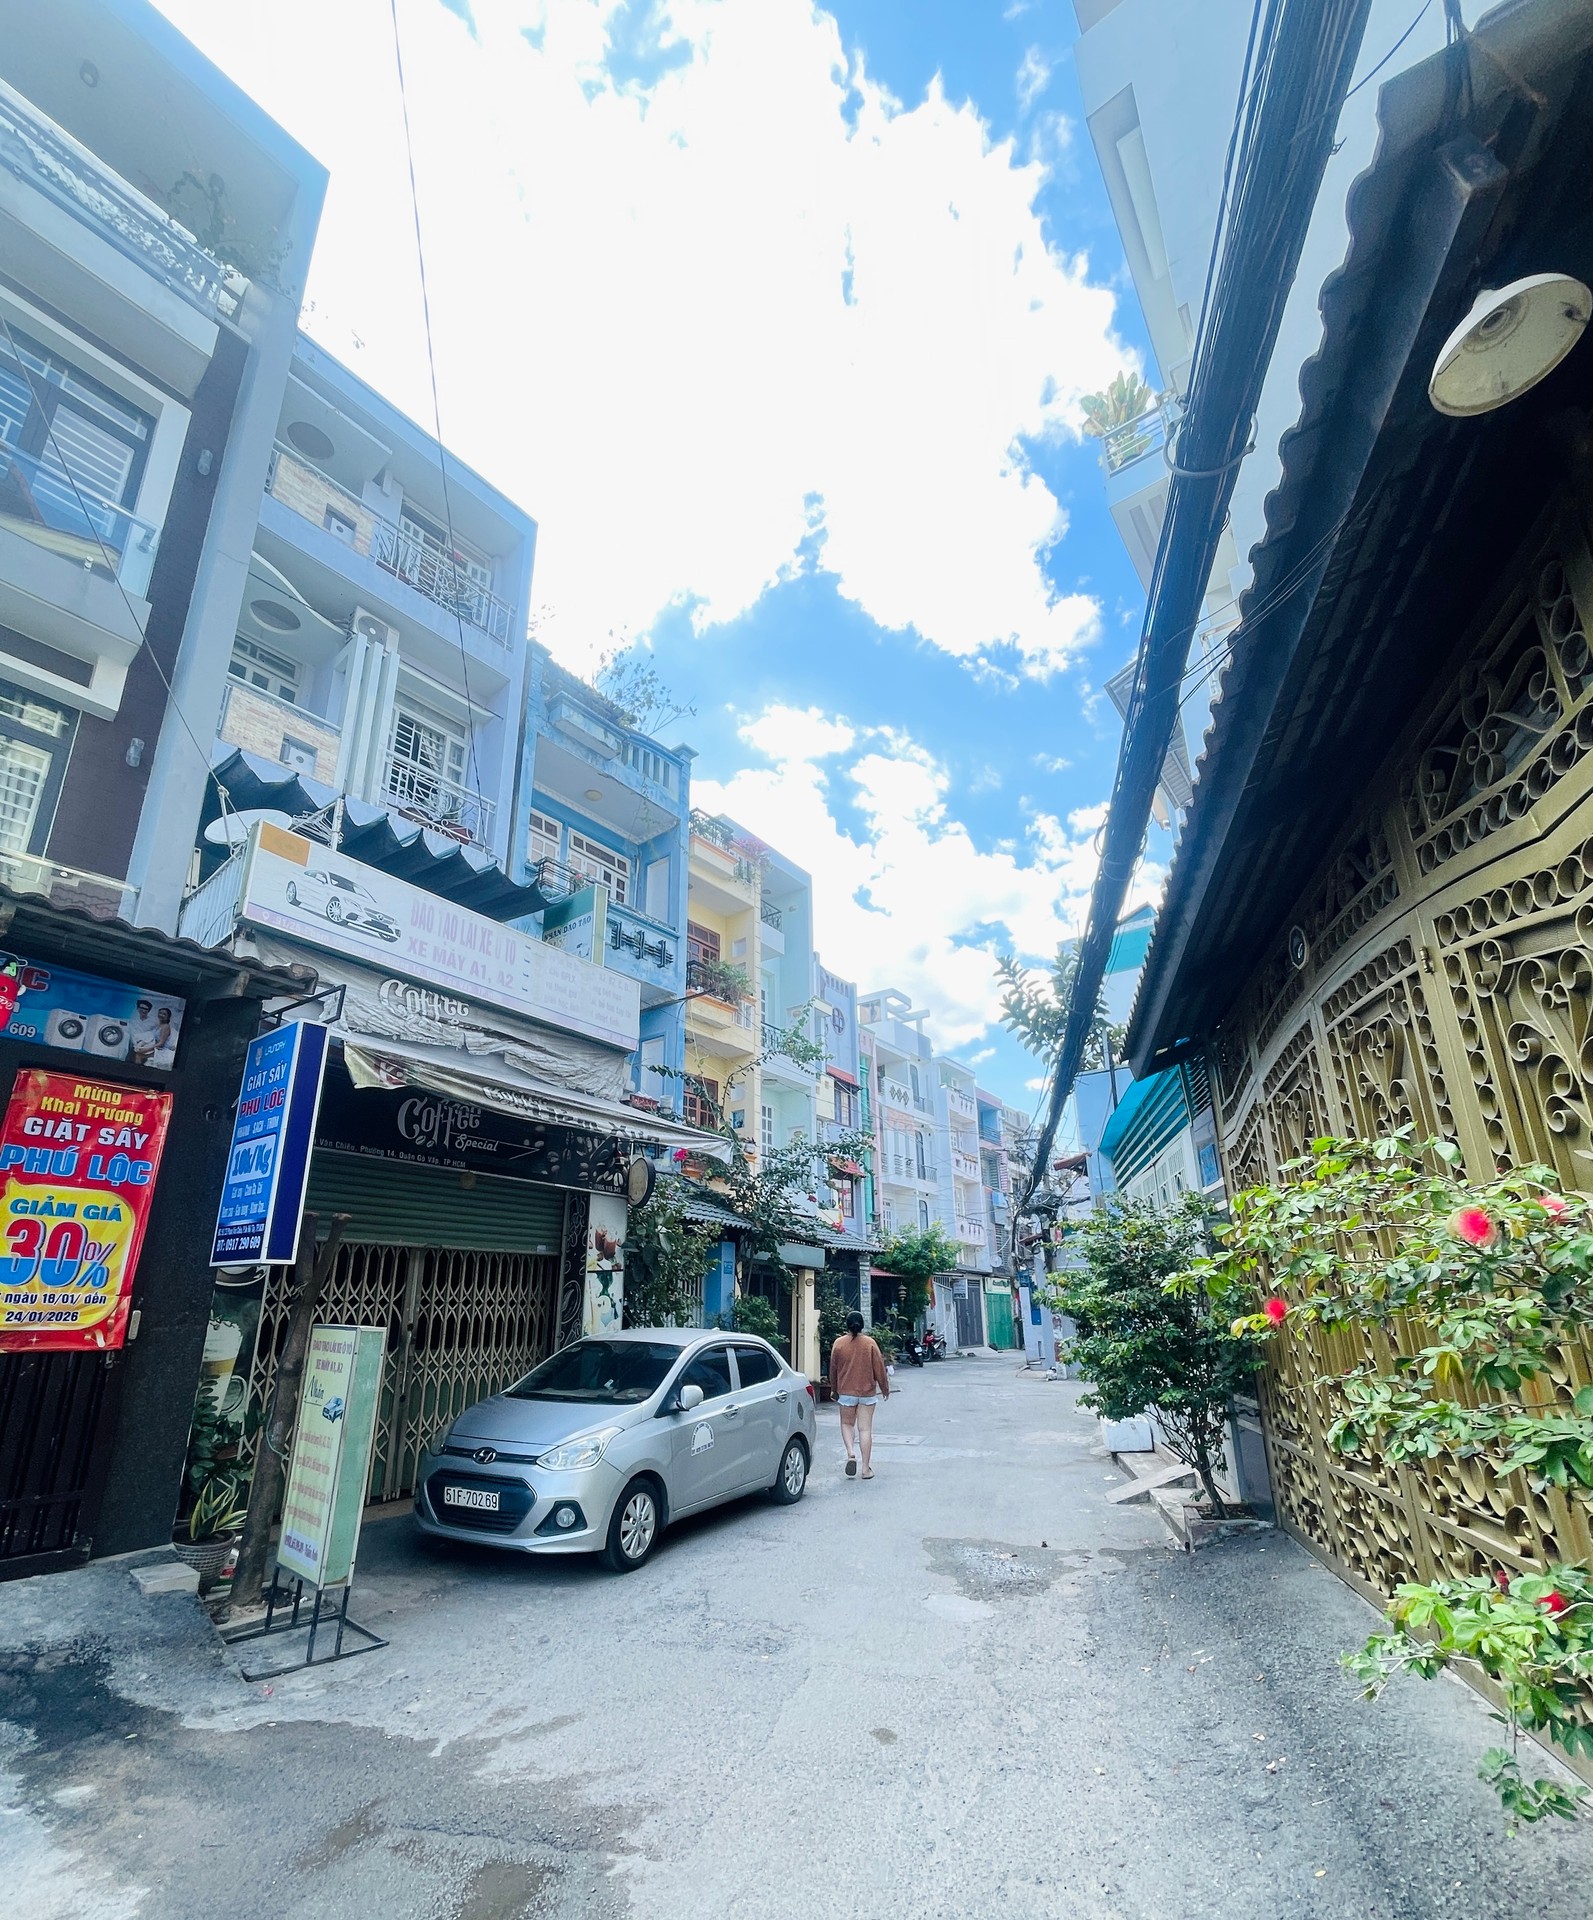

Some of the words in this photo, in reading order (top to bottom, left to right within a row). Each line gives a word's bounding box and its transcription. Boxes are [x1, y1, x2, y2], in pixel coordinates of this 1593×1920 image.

[407, 936, 428, 957] XE
[73, 1084, 122, 1105] Mừng
[40, 1096, 81, 1115] Khai
[86, 1103, 144, 1126] Trương
[23, 1117, 91, 1142] GIẶT
[97, 1126, 149, 1150] SẤY
[455, 1133, 499, 1152] Special
[0, 1143, 80, 1177] PHÚ
[87, 1153, 153, 1187] LỘC
[9, 1195, 78, 1218] GIẢM
[82, 1203, 122, 1222] GIÁ
[0, 1218, 117, 1289] 30%
[4, 1292, 38, 1304] ngày
[84, 1292, 107, 1304] đến
[5, 1311, 79, 1323] 24/01/2026
